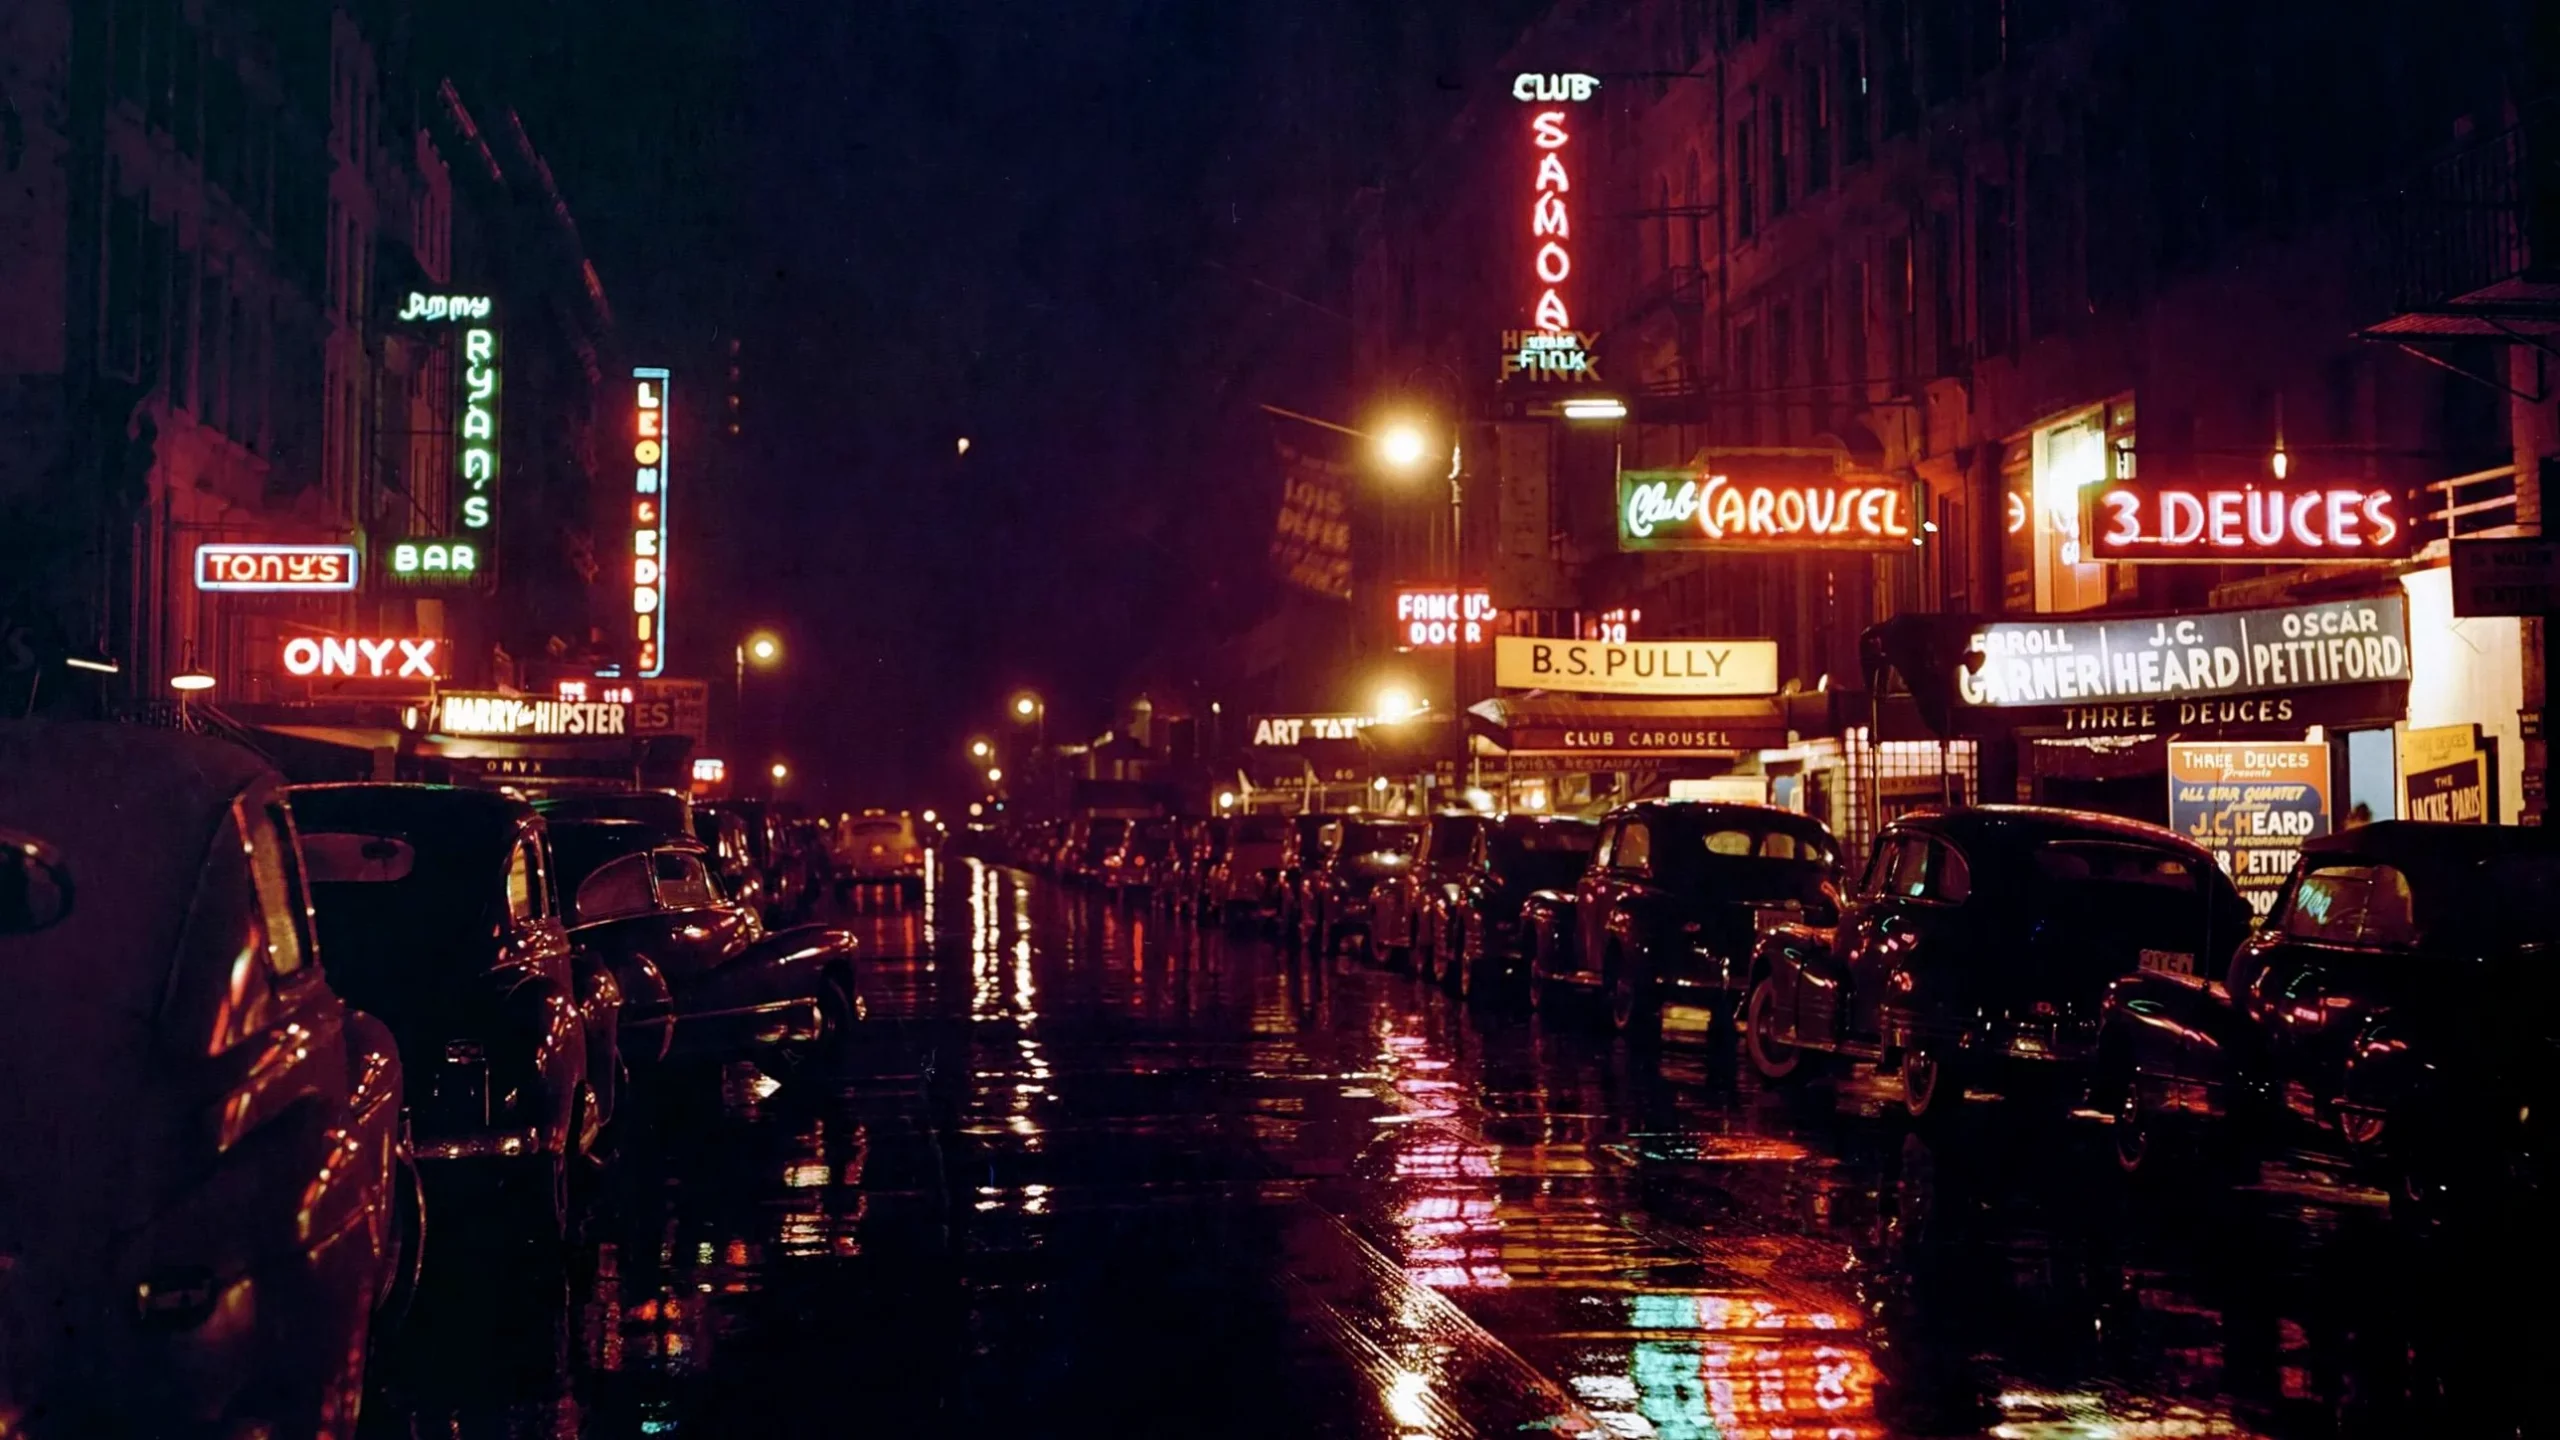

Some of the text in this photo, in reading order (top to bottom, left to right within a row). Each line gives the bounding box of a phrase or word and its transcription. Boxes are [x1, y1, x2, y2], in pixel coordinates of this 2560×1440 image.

[1513, 73, 1600, 101] CLUB
[1533, 111, 1570, 331] SAMOA
[634, 382, 661, 492] LEON
[1628, 476, 1908, 539] Club CAROUSEL
[2104, 490, 2141, 547] 3
[2159, 490, 2398, 547] DEUCES
[210, 555, 339, 582] TONY'S
[395, 544, 475, 571] BAR
[2149, 620, 2204, 647] J.C.
[2282, 608, 2378, 638] OSCAR
[284, 637, 436, 678] ONYX
[1607, 649, 1731, 678] PULLY
[1959, 635, 2401, 705] GARNER HEARD PETTIFORD
[445, 698, 523, 733] HARRY
[535, 701, 625, 734] HIPSTER
[636, 702, 670, 729] ES
[2064, 699, 2293, 730] THREE DEUCES
[1254, 719, 1303, 745] ART
[1565, 731, 1731, 746] CLUB CAROUSEL
[487, 761, 542, 773] ONYX
[2183, 751, 2309, 769] THREE DEUCES
[2179, 786, 2205, 802] ALL
[2435, 775, 2452, 788] THE
[2452, 786, 2480, 821] PARIS
[2235, 811, 2314, 835] HEARD
[2235, 849, 2301, 875] PETTIF
